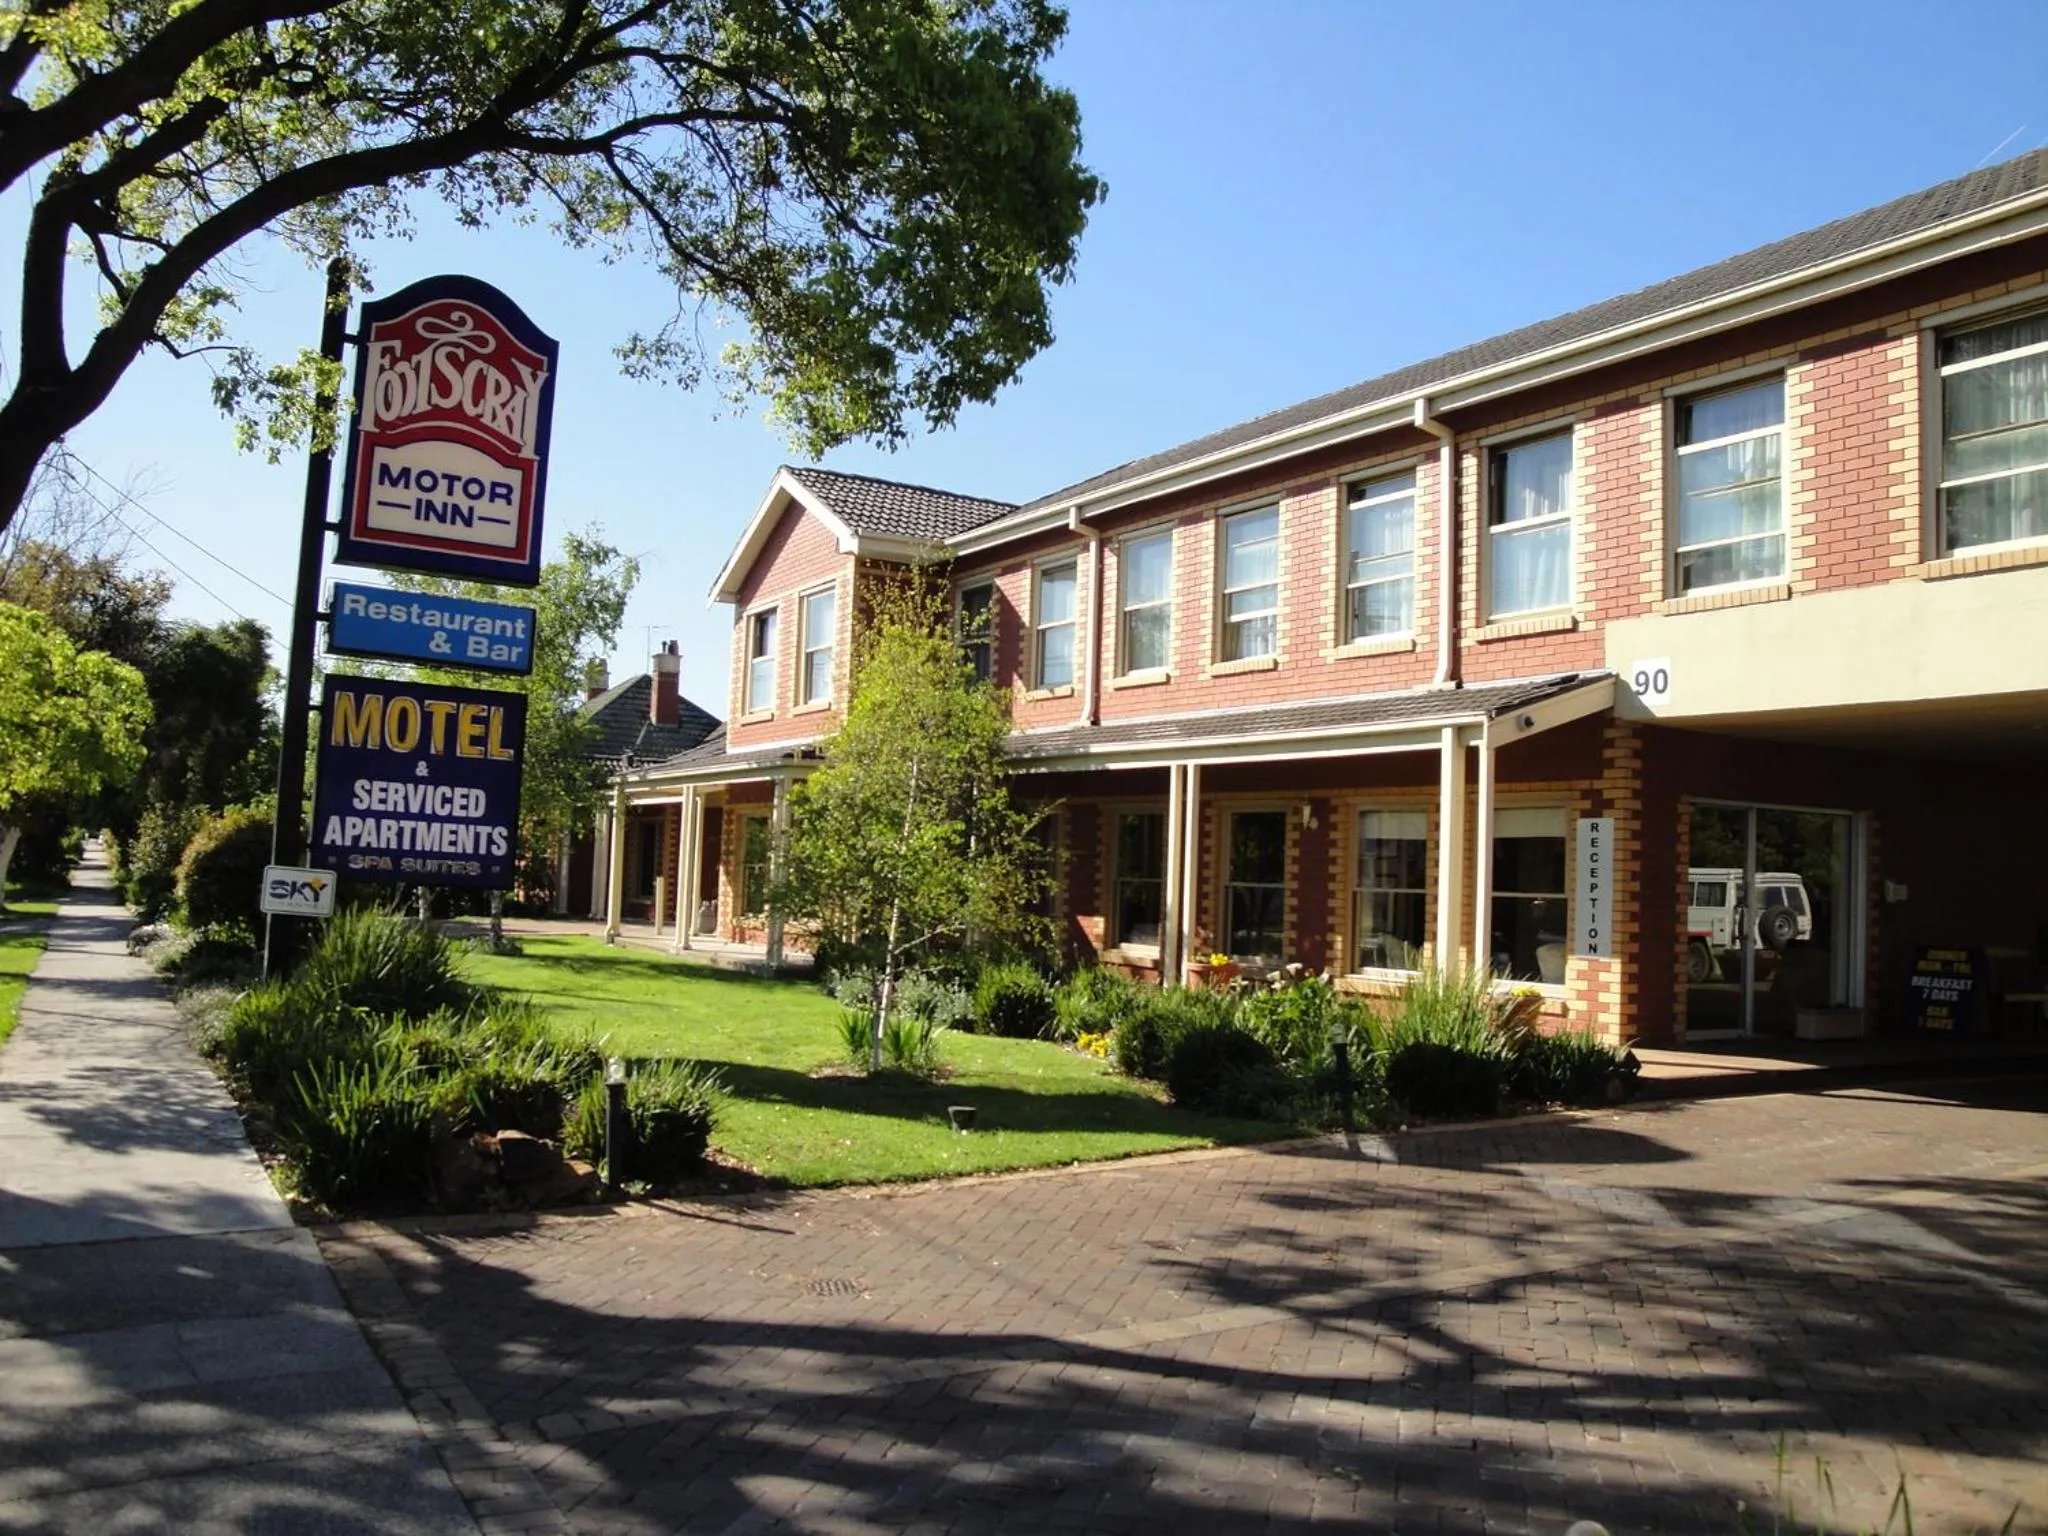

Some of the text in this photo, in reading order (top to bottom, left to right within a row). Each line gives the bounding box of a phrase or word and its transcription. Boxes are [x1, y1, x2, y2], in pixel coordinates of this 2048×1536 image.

[378, 462, 514, 506] MOTOR
[413, 497, 475, 528] INN
[342, 592, 527, 639] Restaurant
[429, 630, 524, 663] & Bar
[1634, 668, 1669, 696] 90
[330, 690, 514, 761] MOTEL
[415, 760, 430, 777] &
[352, 778, 487, 818] SERVICED
[323, 815, 509, 857] APARTMENTS
[348, 854, 482, 876] SPA SUITES
[269, 878, 328, 903] SKY
[1587, 822, 1601, 955] RECEPTION
